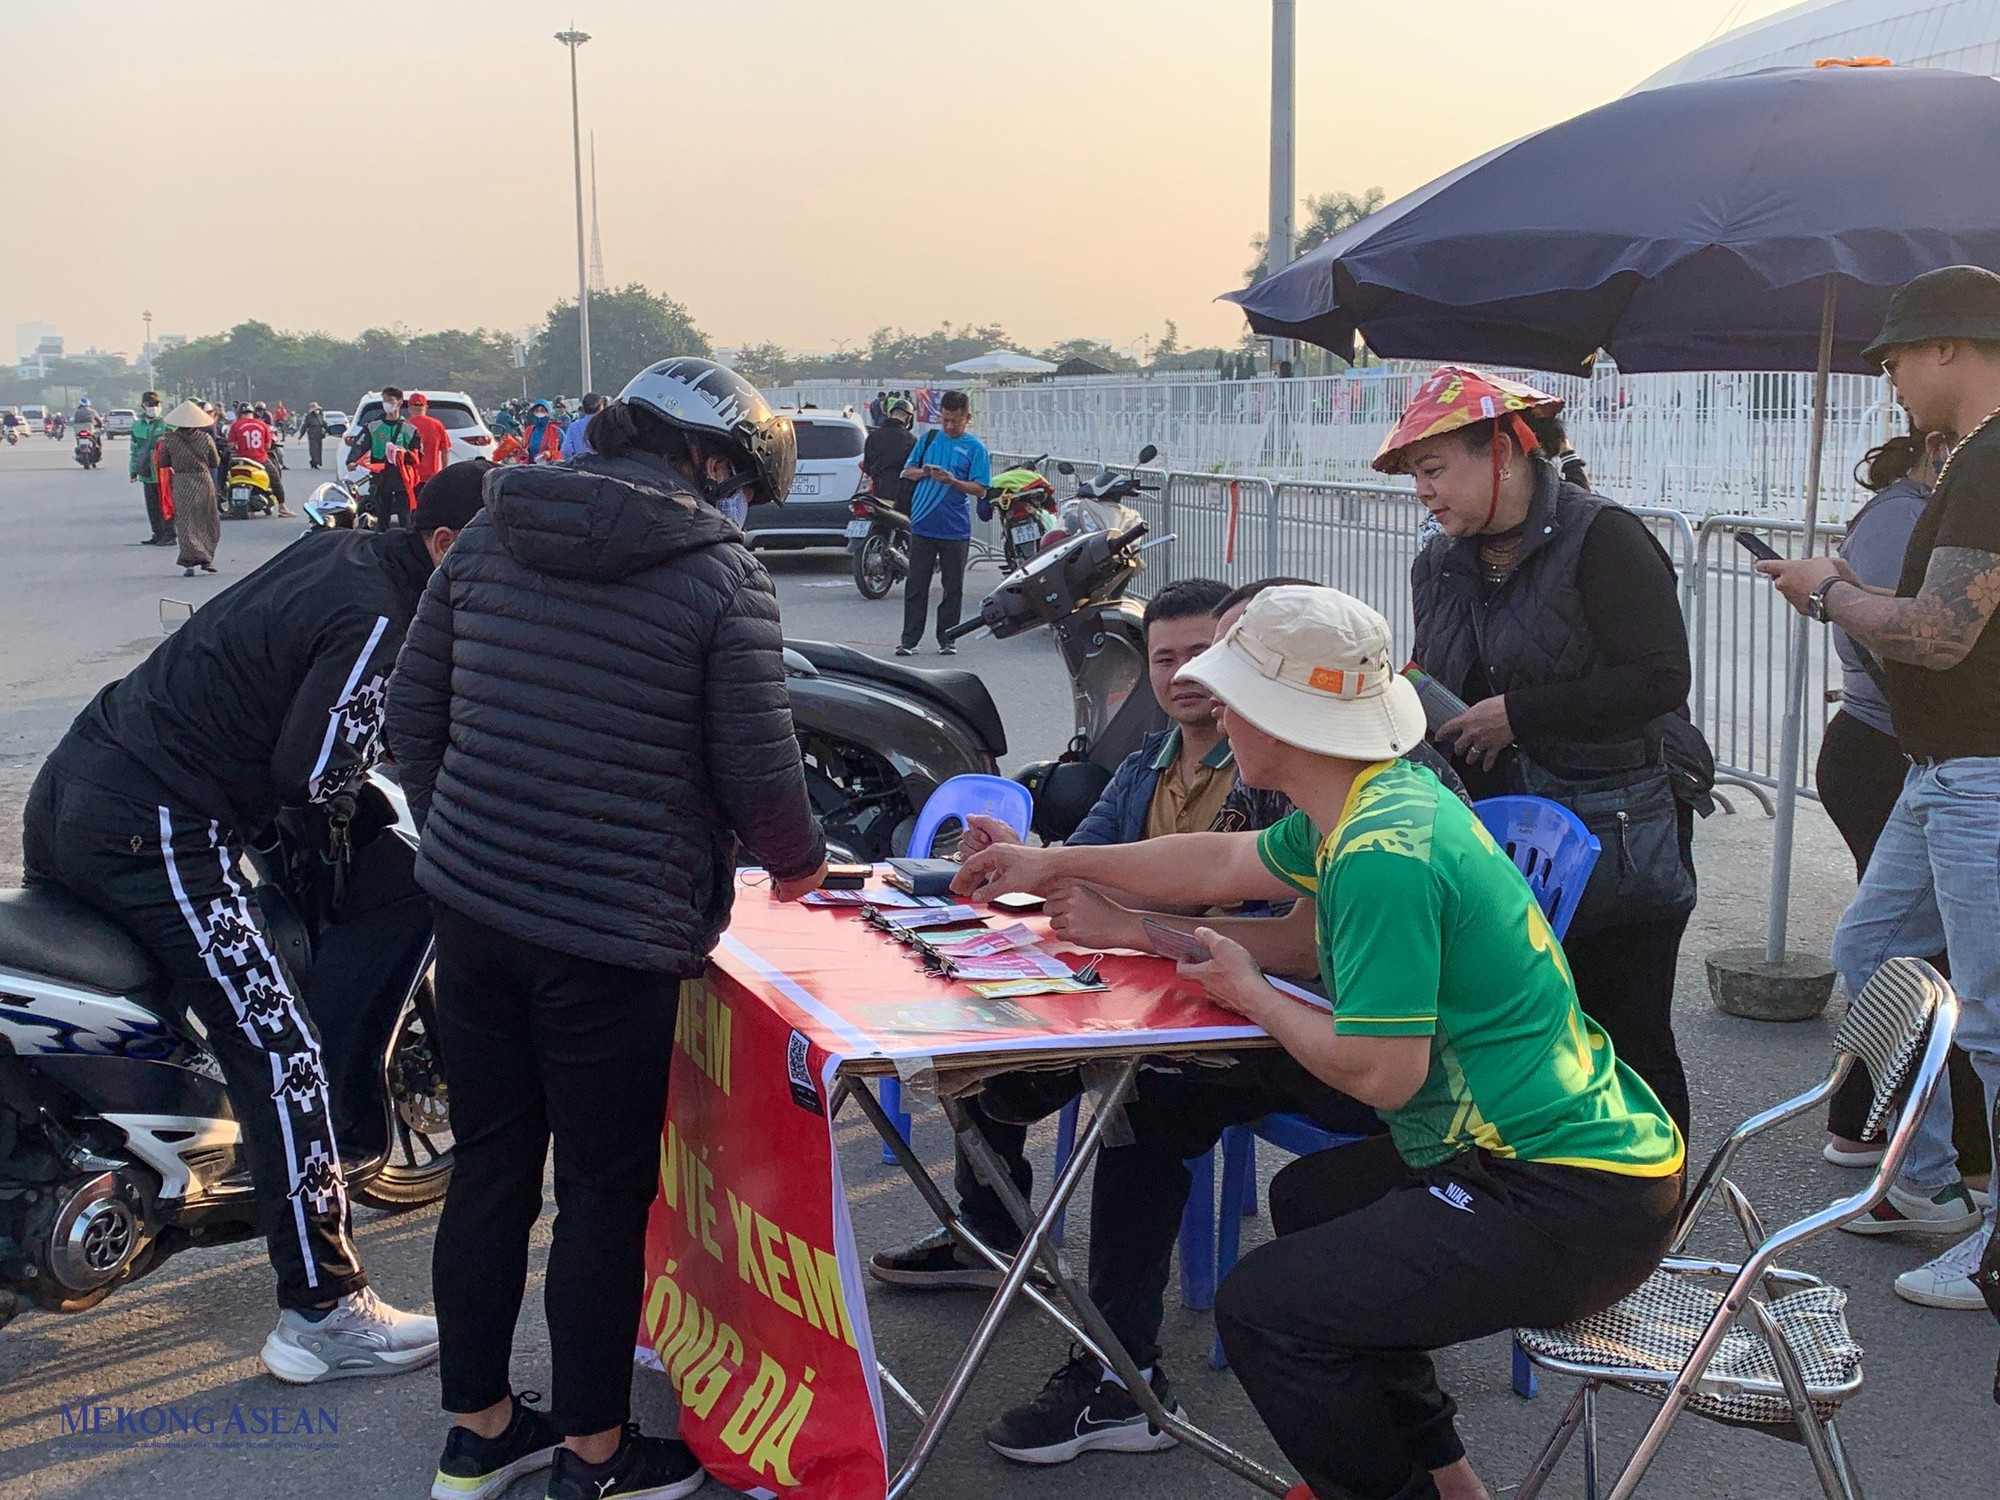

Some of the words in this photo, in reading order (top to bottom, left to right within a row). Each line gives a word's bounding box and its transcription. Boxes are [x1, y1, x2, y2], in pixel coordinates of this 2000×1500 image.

[242, 429, 262, 449] 18
[681, 1137, 724, 1263] VÉ
[726, 1187, 859, 1350] XEM
[1445, 1182, 1474, 1207] NIKE
[644, 1258, 744, 1421] ÓNG
[719, 1351, 816, 1486] ĐÁ
